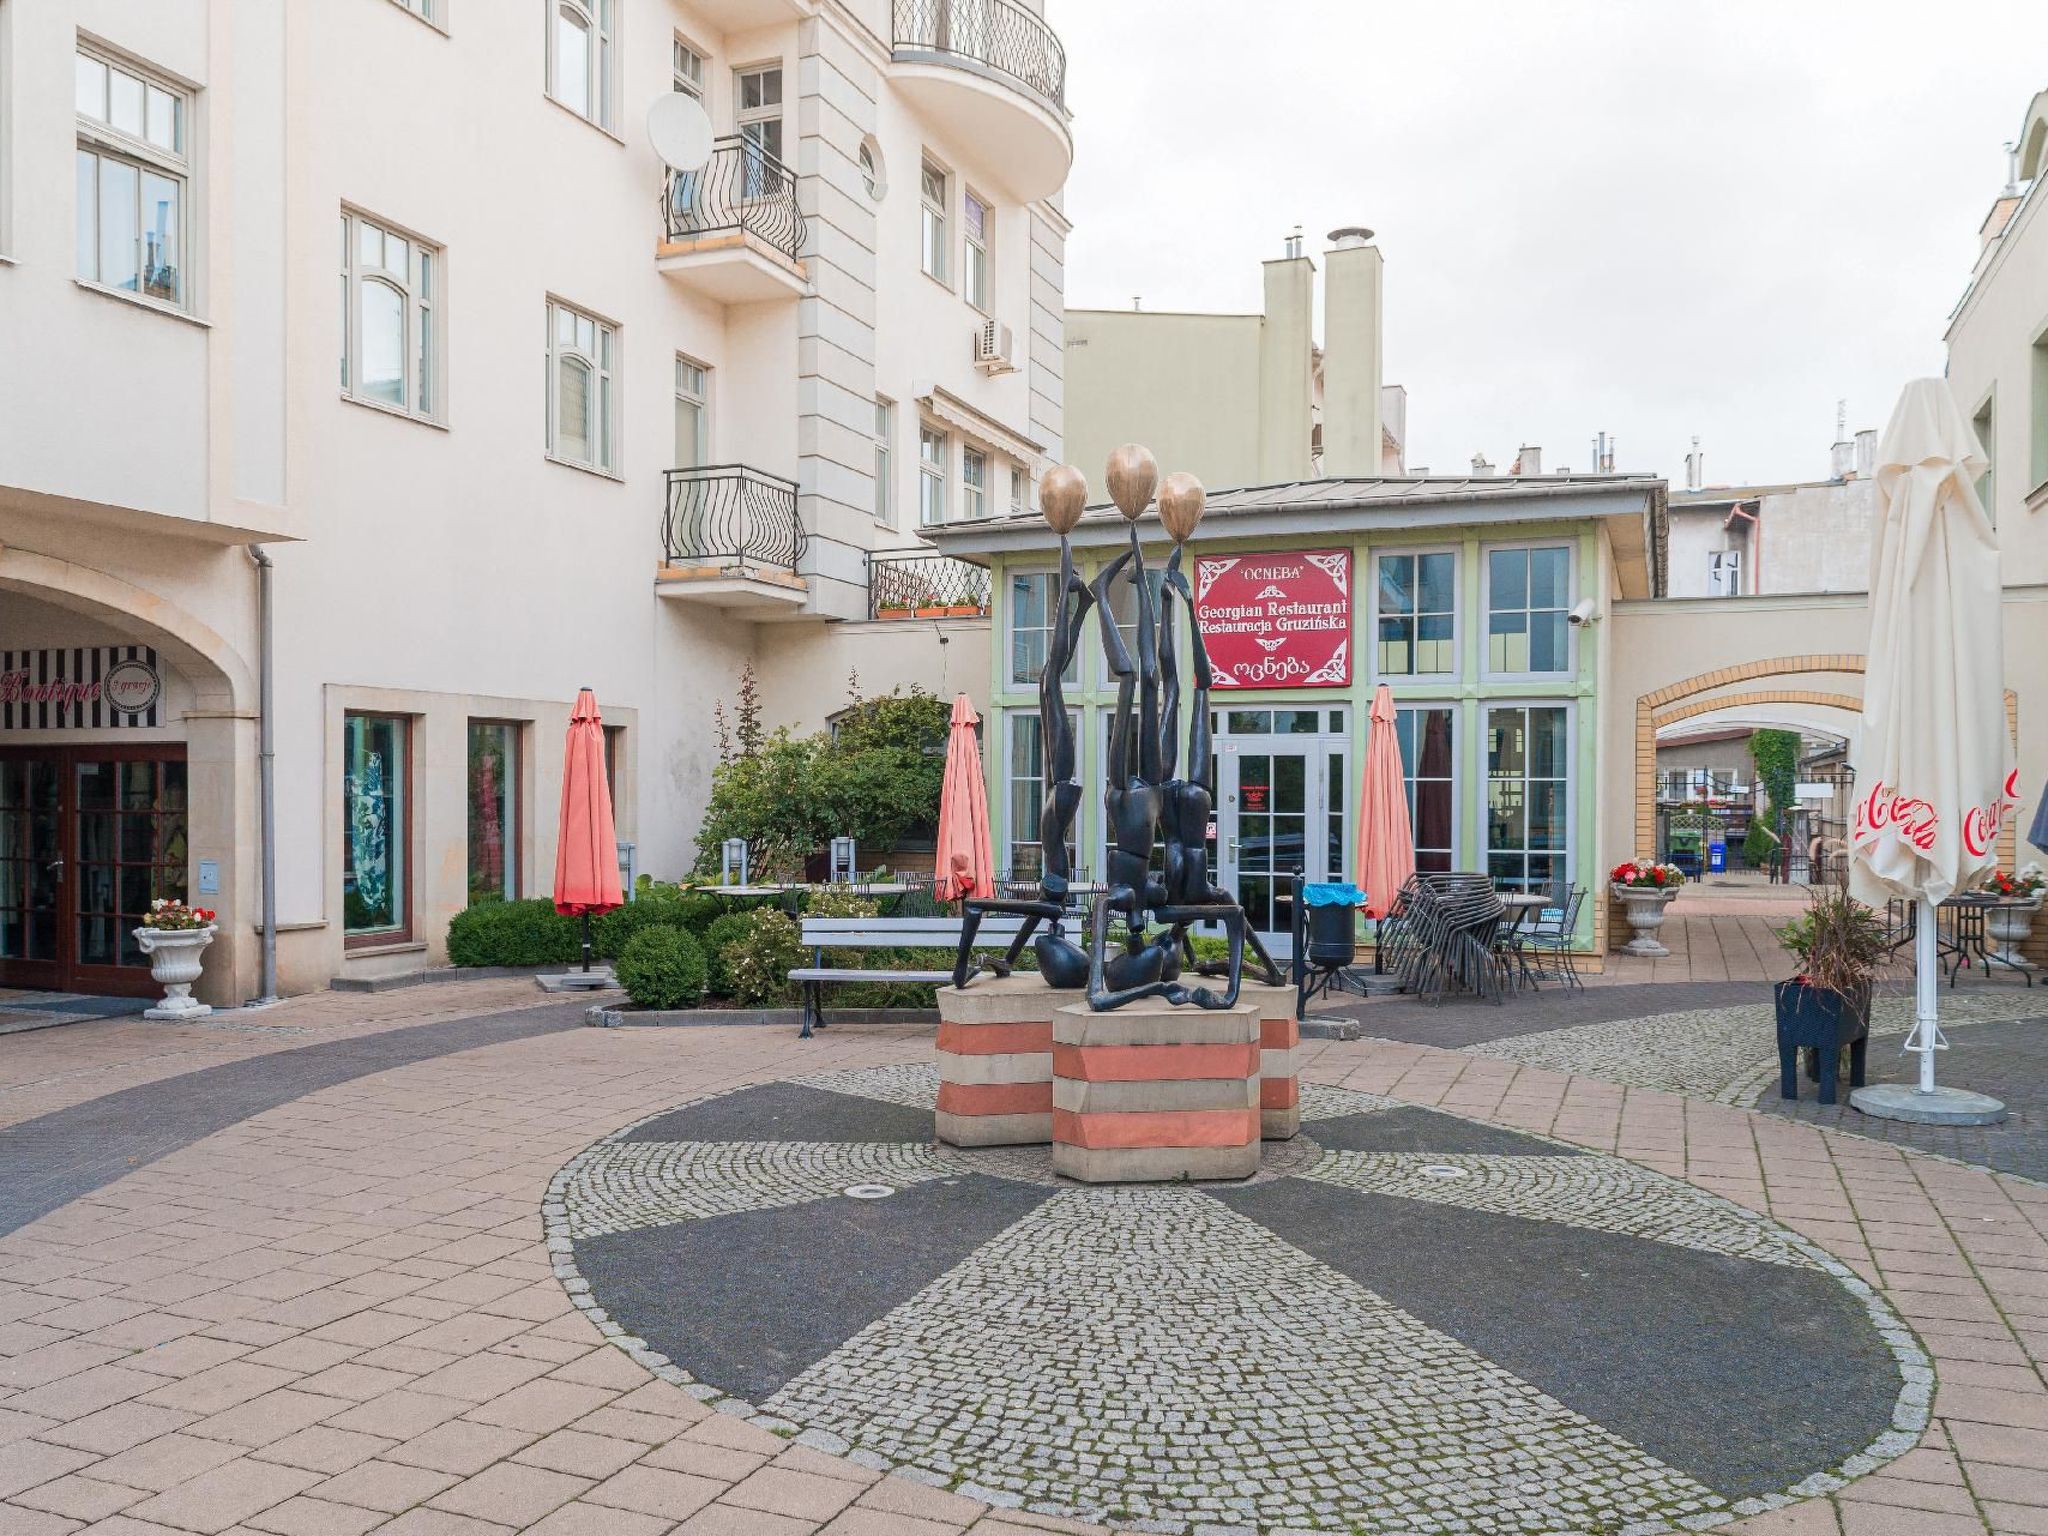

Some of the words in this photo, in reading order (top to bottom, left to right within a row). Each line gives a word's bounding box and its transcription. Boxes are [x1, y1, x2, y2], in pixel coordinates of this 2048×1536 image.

[1199, 604, 1263, 620] Georgian
[1267, 600, 1347, 616] Restaurant
[1200, 619, 1272, 634] Restauracja
[1276, 613, 1346, 631] Gruzińska
